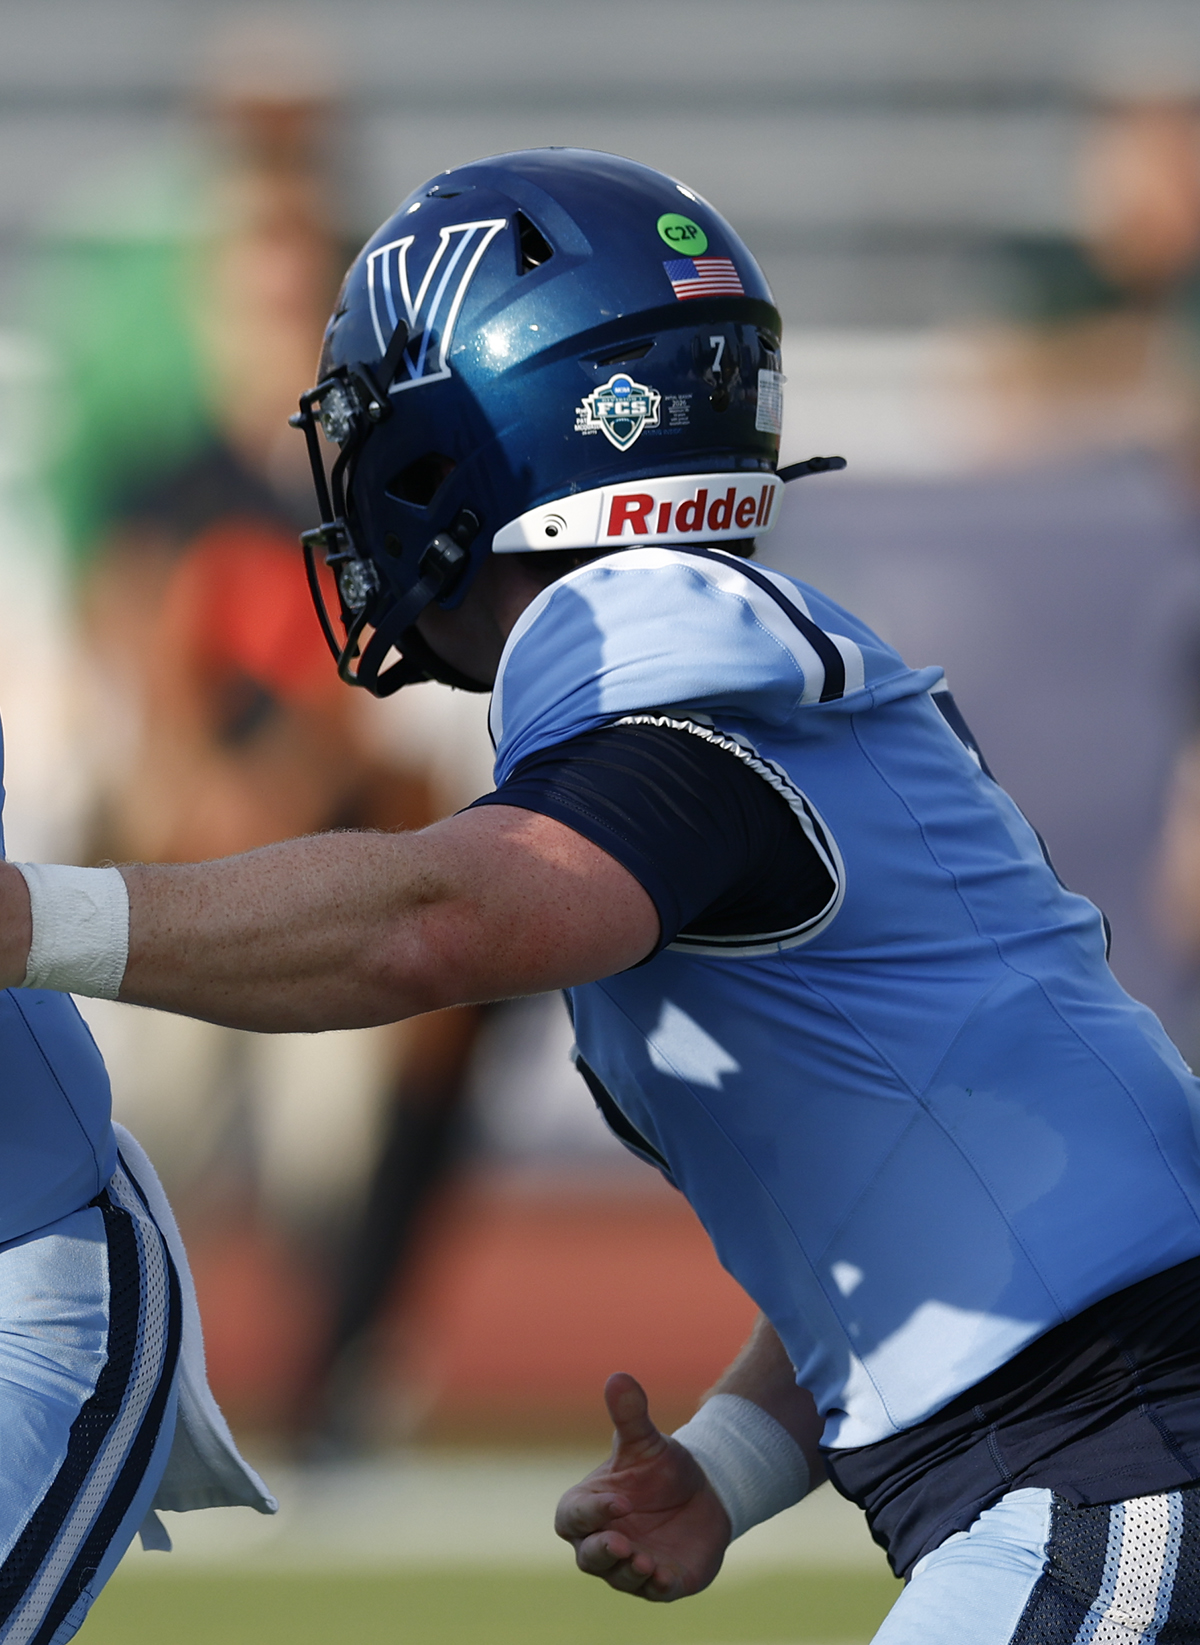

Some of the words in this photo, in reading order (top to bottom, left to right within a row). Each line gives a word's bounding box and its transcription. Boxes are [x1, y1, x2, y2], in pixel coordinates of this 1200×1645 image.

[664, 225, 698, 241] C2P
[366, 218, 507, 394] V
[709, 335, 725, 373] 7
[597, 401, 647, 415] FCS
[607, 485, 776, 537] Riddell
